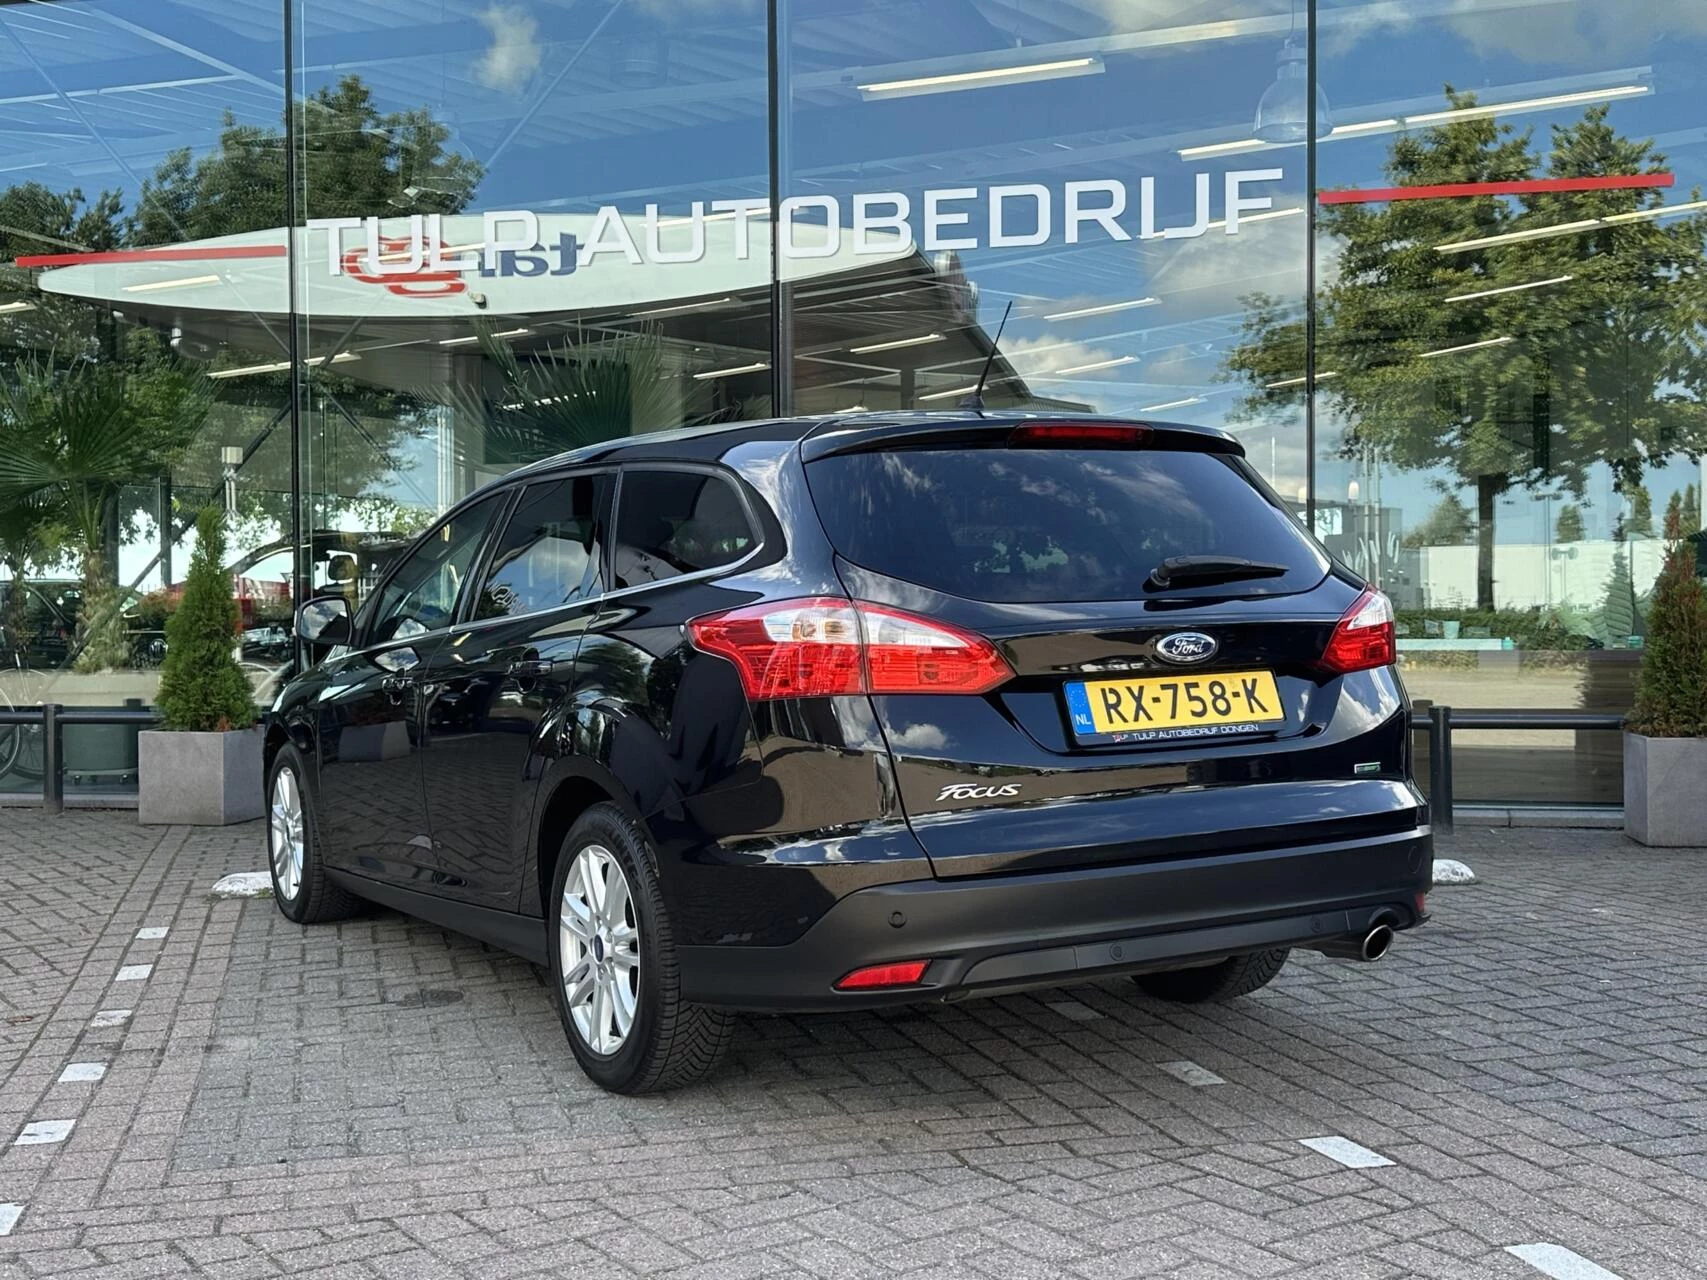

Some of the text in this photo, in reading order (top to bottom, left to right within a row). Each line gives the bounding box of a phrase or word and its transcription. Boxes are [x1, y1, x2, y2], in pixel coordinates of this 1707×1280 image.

[306, 167, 1284, 276] TULP AUTOBEDRIJF
[1172, 637, 1205, 655] Ford
[1100, 678, 1269, 725] RX-758-K
[1075, 713, 1092, 726] NL
[1132, 724, 1260, 741] TULP AUTOBEDRIJF DONGEN
